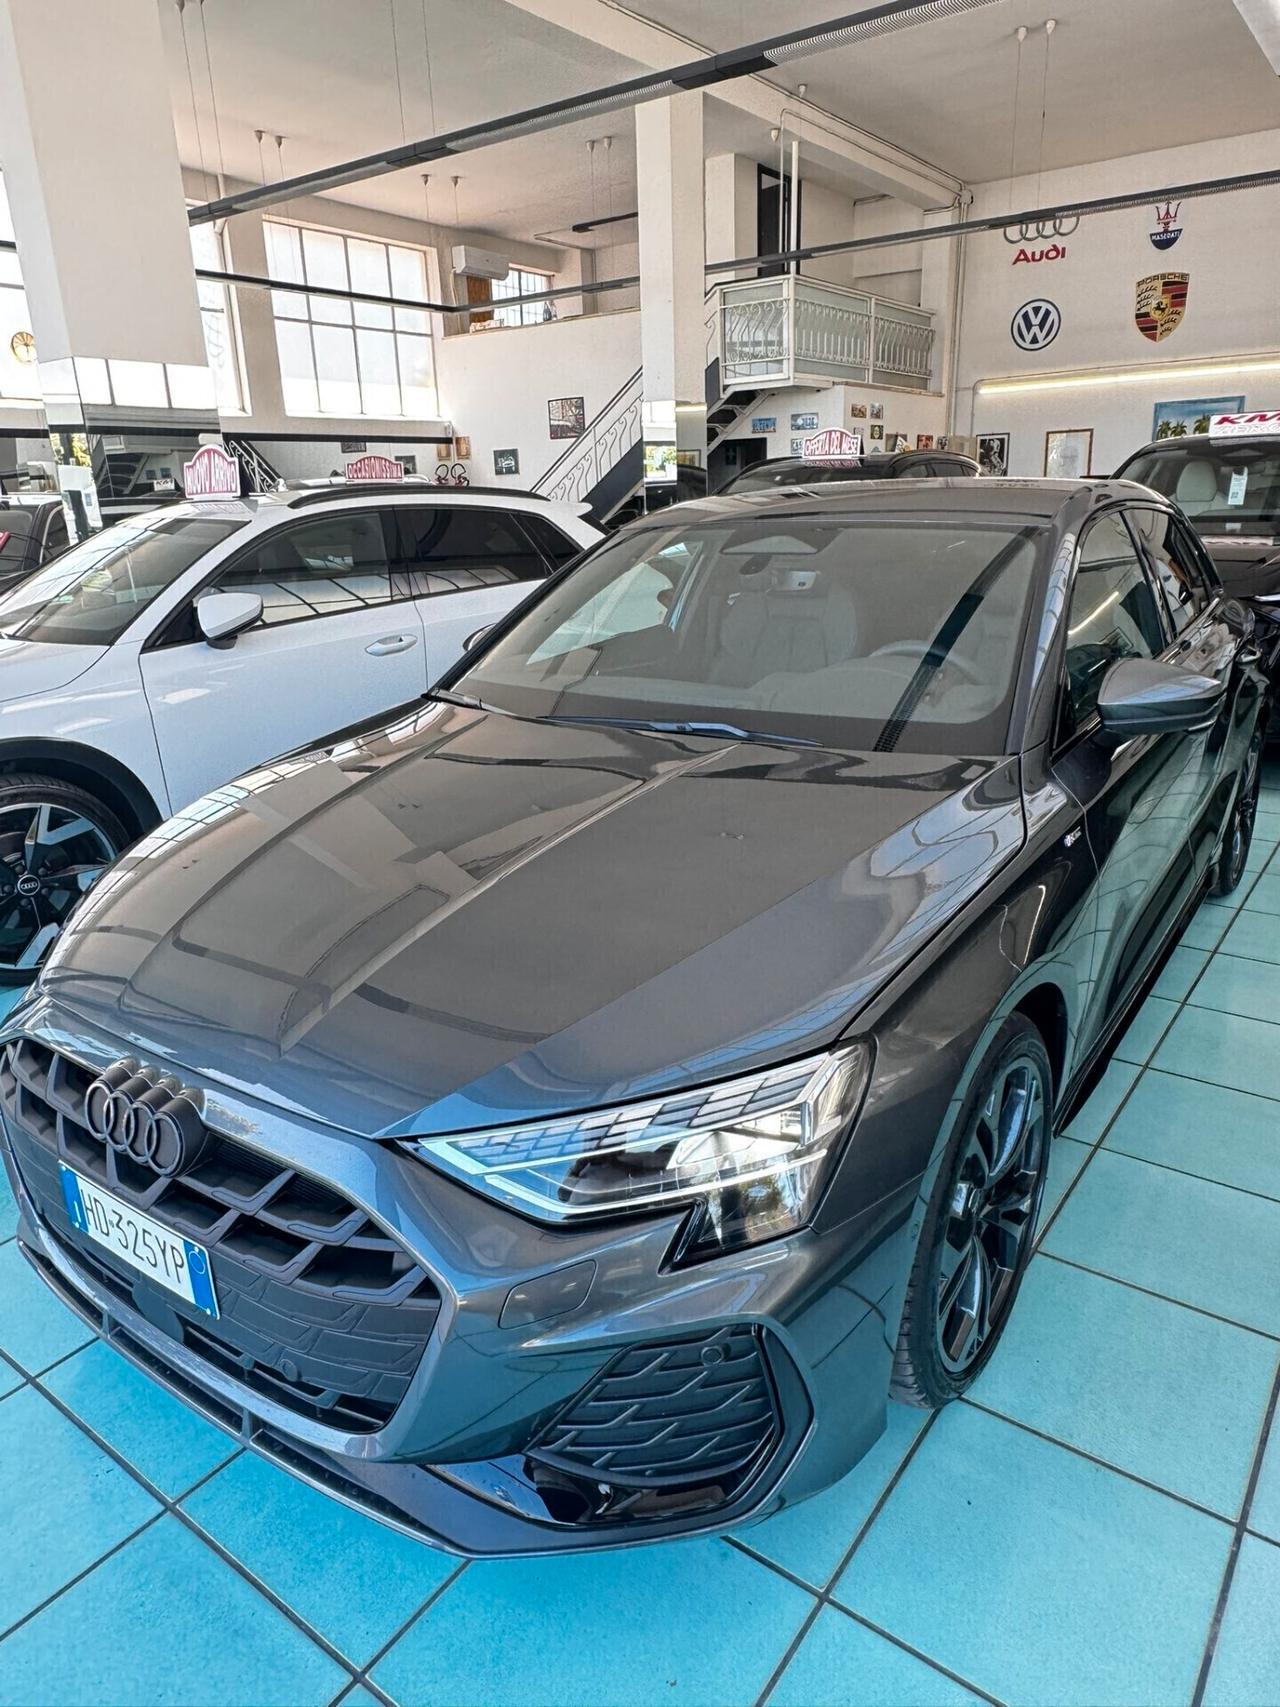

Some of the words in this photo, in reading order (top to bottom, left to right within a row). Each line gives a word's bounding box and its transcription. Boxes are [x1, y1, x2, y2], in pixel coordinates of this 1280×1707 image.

[1012, 243, 1066, 266] Audi
[1136, 272, 1190, 287] PORSCHE
[186, 452, 210, 494] NUOVO
[210, 450, 237, 492] ARRIVO
